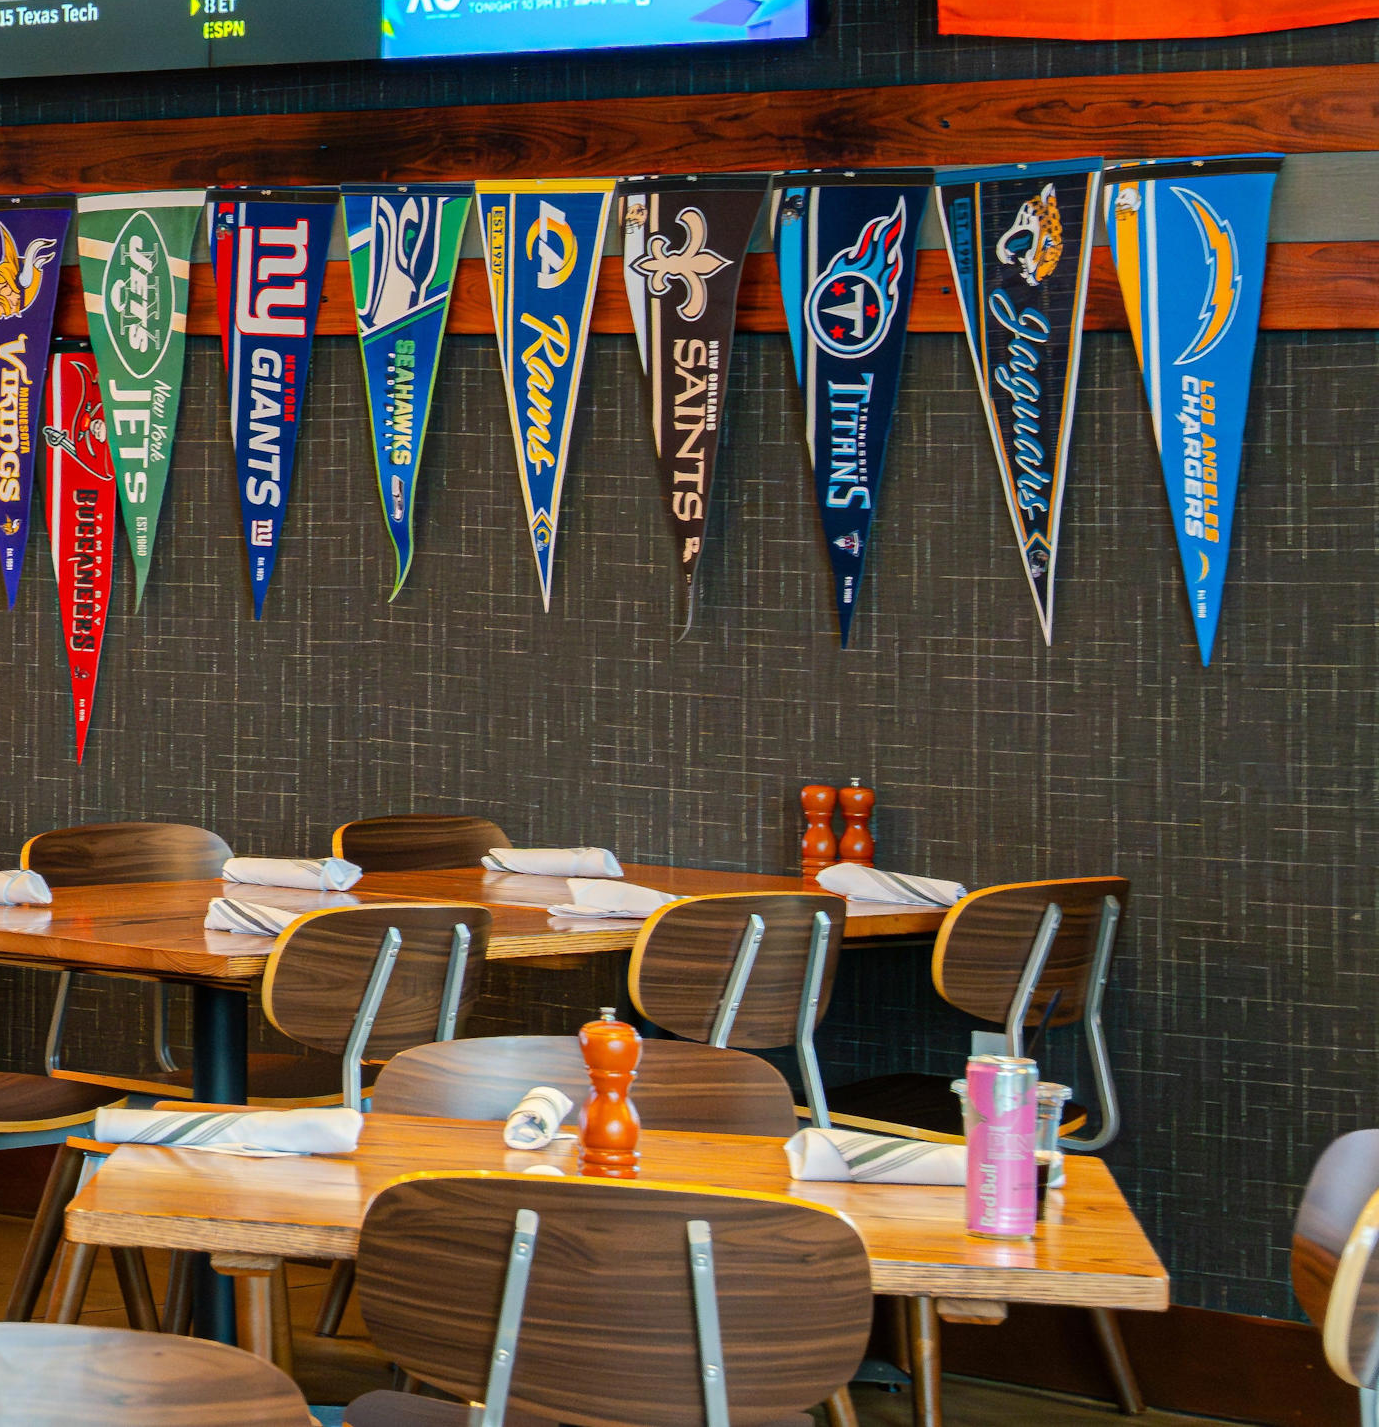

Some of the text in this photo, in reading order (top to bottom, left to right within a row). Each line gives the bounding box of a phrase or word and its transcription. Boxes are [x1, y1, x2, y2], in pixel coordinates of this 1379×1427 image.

[16, 5, 59, 26] Texas
[61, 2, 99, 24] Tech
[203, 20, 245, 40] ESPN
[468, 0, 518, 14] TONIGHT
[19, 386, 31, 454] MINNESOTA
[109, 379, 153, 504] JETS
[149, 379, 175, 464] New York
[246, 348, 283, 508] GIANTS
[283, 354, 296, 422] NEW YORK
[392, 339, 415, 465] SEAHAWKS
[520, 312, 571, 475] Rams
[672, 339, 707, 521] SAINTS
[706, 340, 719, 431] NEW ORLEANS
[826, 373, 874, 509] TITANS
[858, 405, 868, 483] TENNESSEE
[988, 289, 1053, 520] Jaguars
[1181, 374, 1204, 539] CHARGERS
[1199, 380, 1220, 543] LOS ANGELES
[71, 488, 98, 653] BUCCANEERS
[979, 1163, 996, 1227] Red Bull
